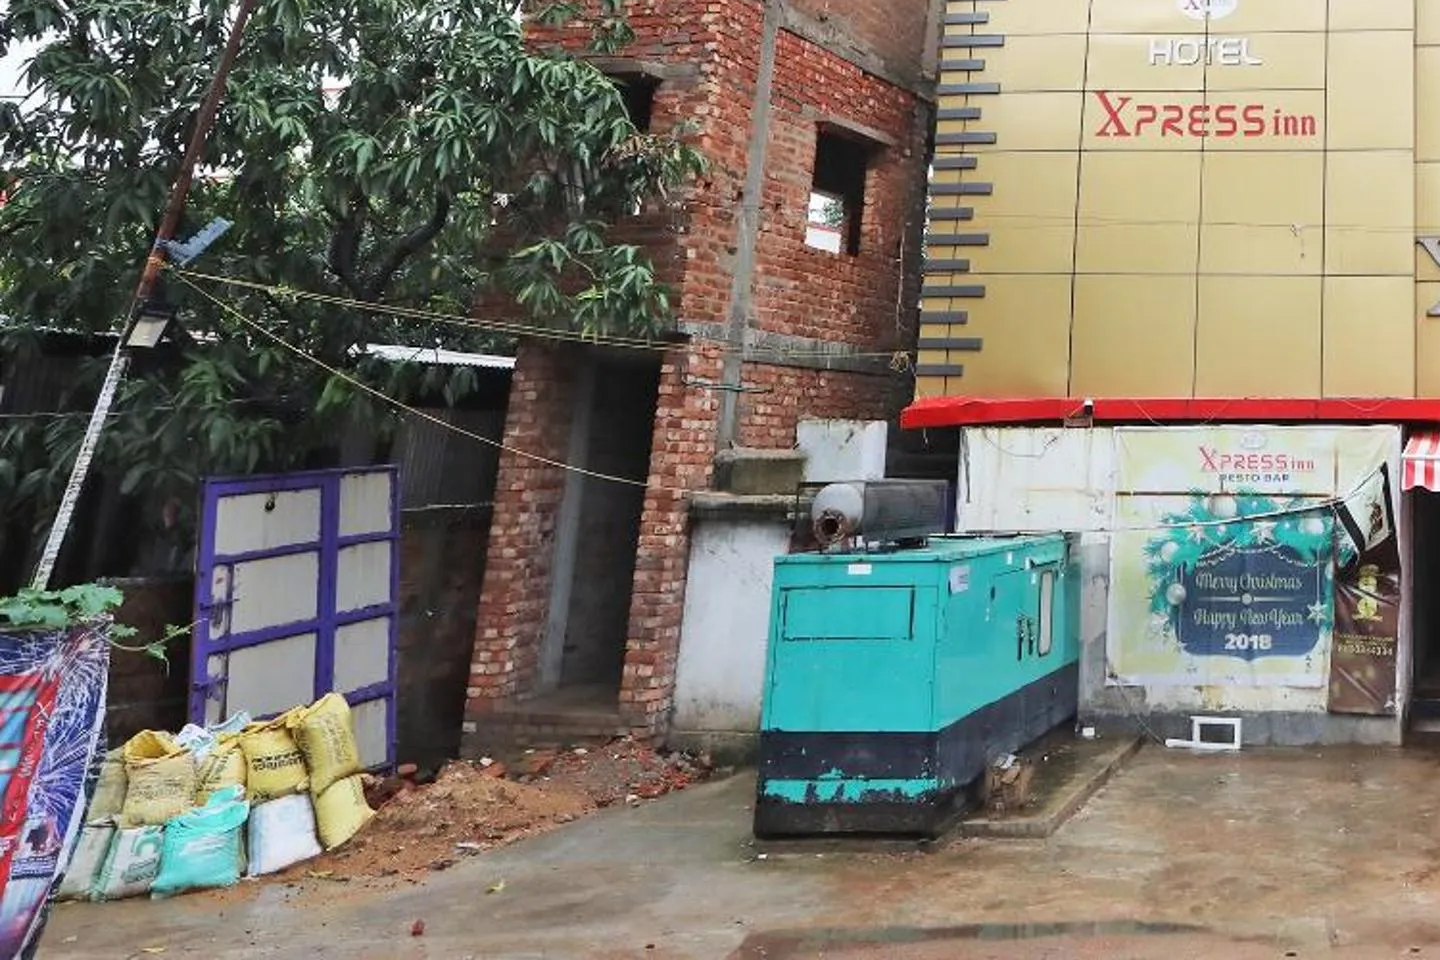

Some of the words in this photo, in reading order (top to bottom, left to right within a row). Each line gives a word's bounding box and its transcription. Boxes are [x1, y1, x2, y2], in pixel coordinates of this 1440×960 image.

[1149, 38, 1264, 66] HOTEL
[1094, 90, 1267, 138] XPRESS
[1272, 108, 1317, 137] inn
[1199, 446, 1287, 472] XPRESS
[1290, 455, 1315, 470] inn
[1219, 473, 1260, 483] RESTO
[1263, 473, 1290, 483] BAR
[1195, 572, 1238, 594] Merry
[1240, 573, 1303, 591] Christmas
[1193, 608, 1237, 630] Happy
[1239, 608, 1268, 626] New
[1224, 633, 1272, 650] 2018
